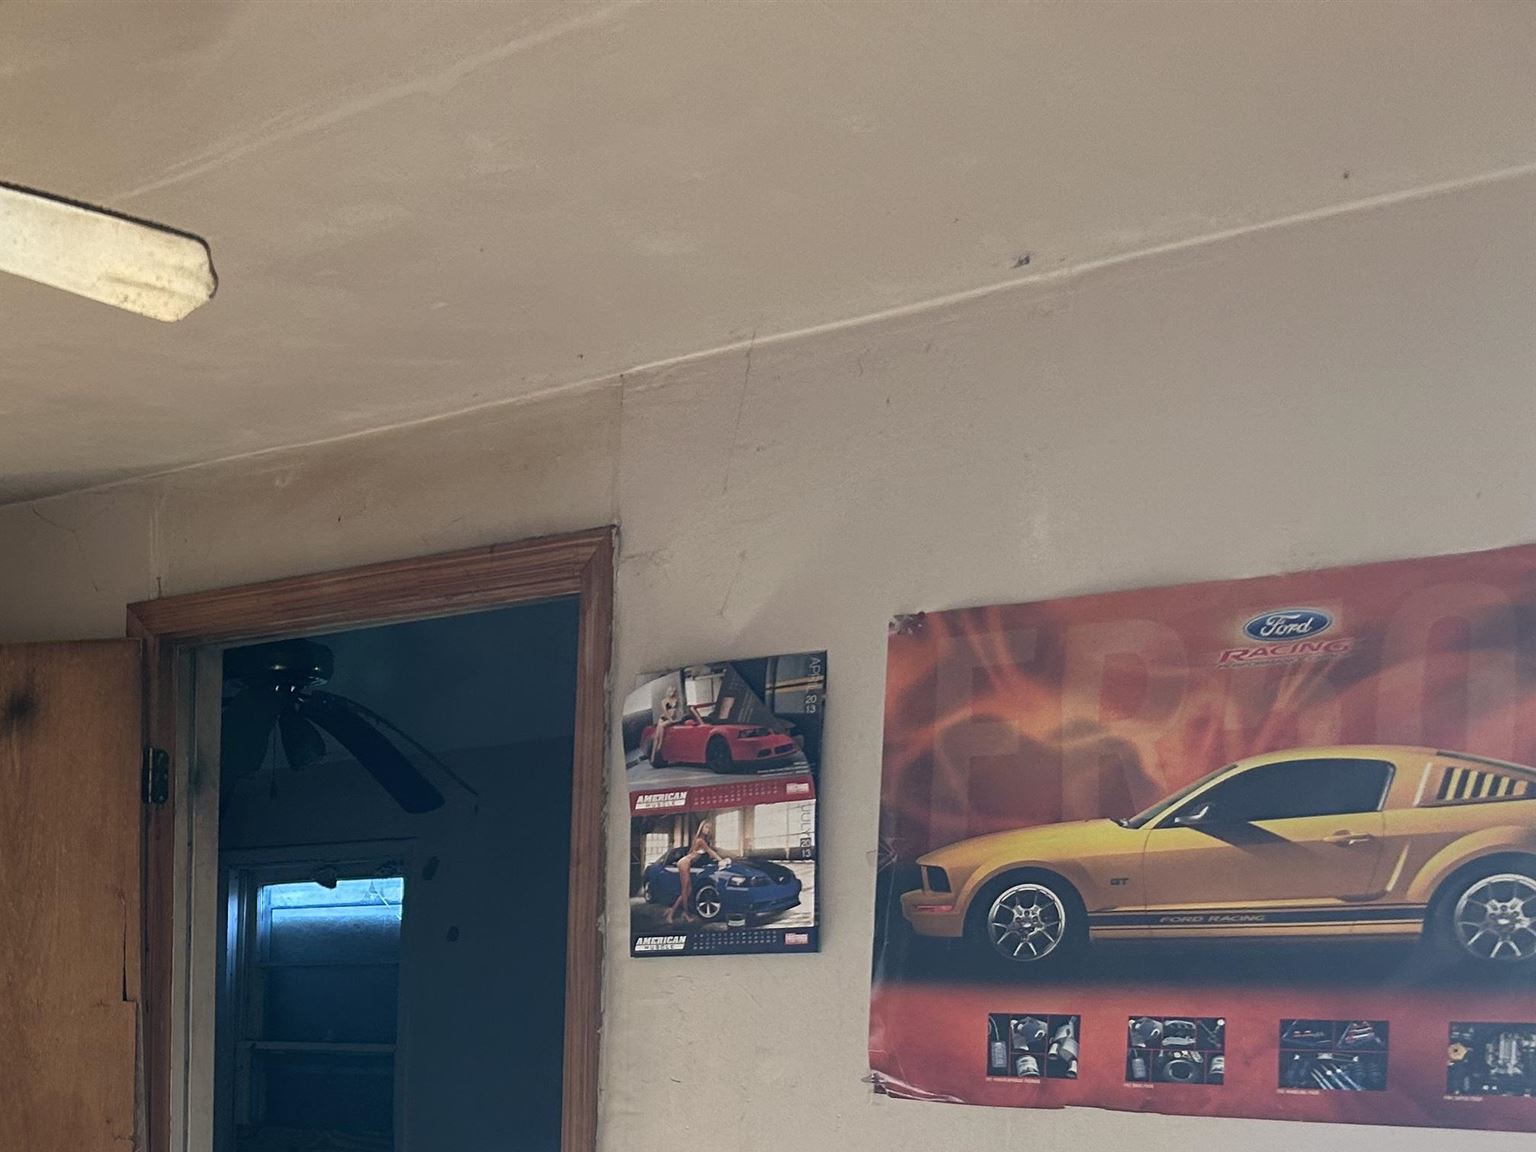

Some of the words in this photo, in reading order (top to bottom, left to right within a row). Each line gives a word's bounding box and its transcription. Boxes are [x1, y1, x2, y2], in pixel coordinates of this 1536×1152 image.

[1260, 613, 1314, 637] Ford
[1218, 637, 1354, 664] RACING
[805, 694, 817, 704] 20
[806, 704, 816, 714] 13
[636, 791, 688, 803] AMERICAN
[801, 802, 813, 837] JULY
[1110, 877, 1129, 886] GT
[1160, 915, 1204, 923] FORD
[1207, 914, 1265, 923] RACING
[636, 935, 687, 945] AMERICAN
